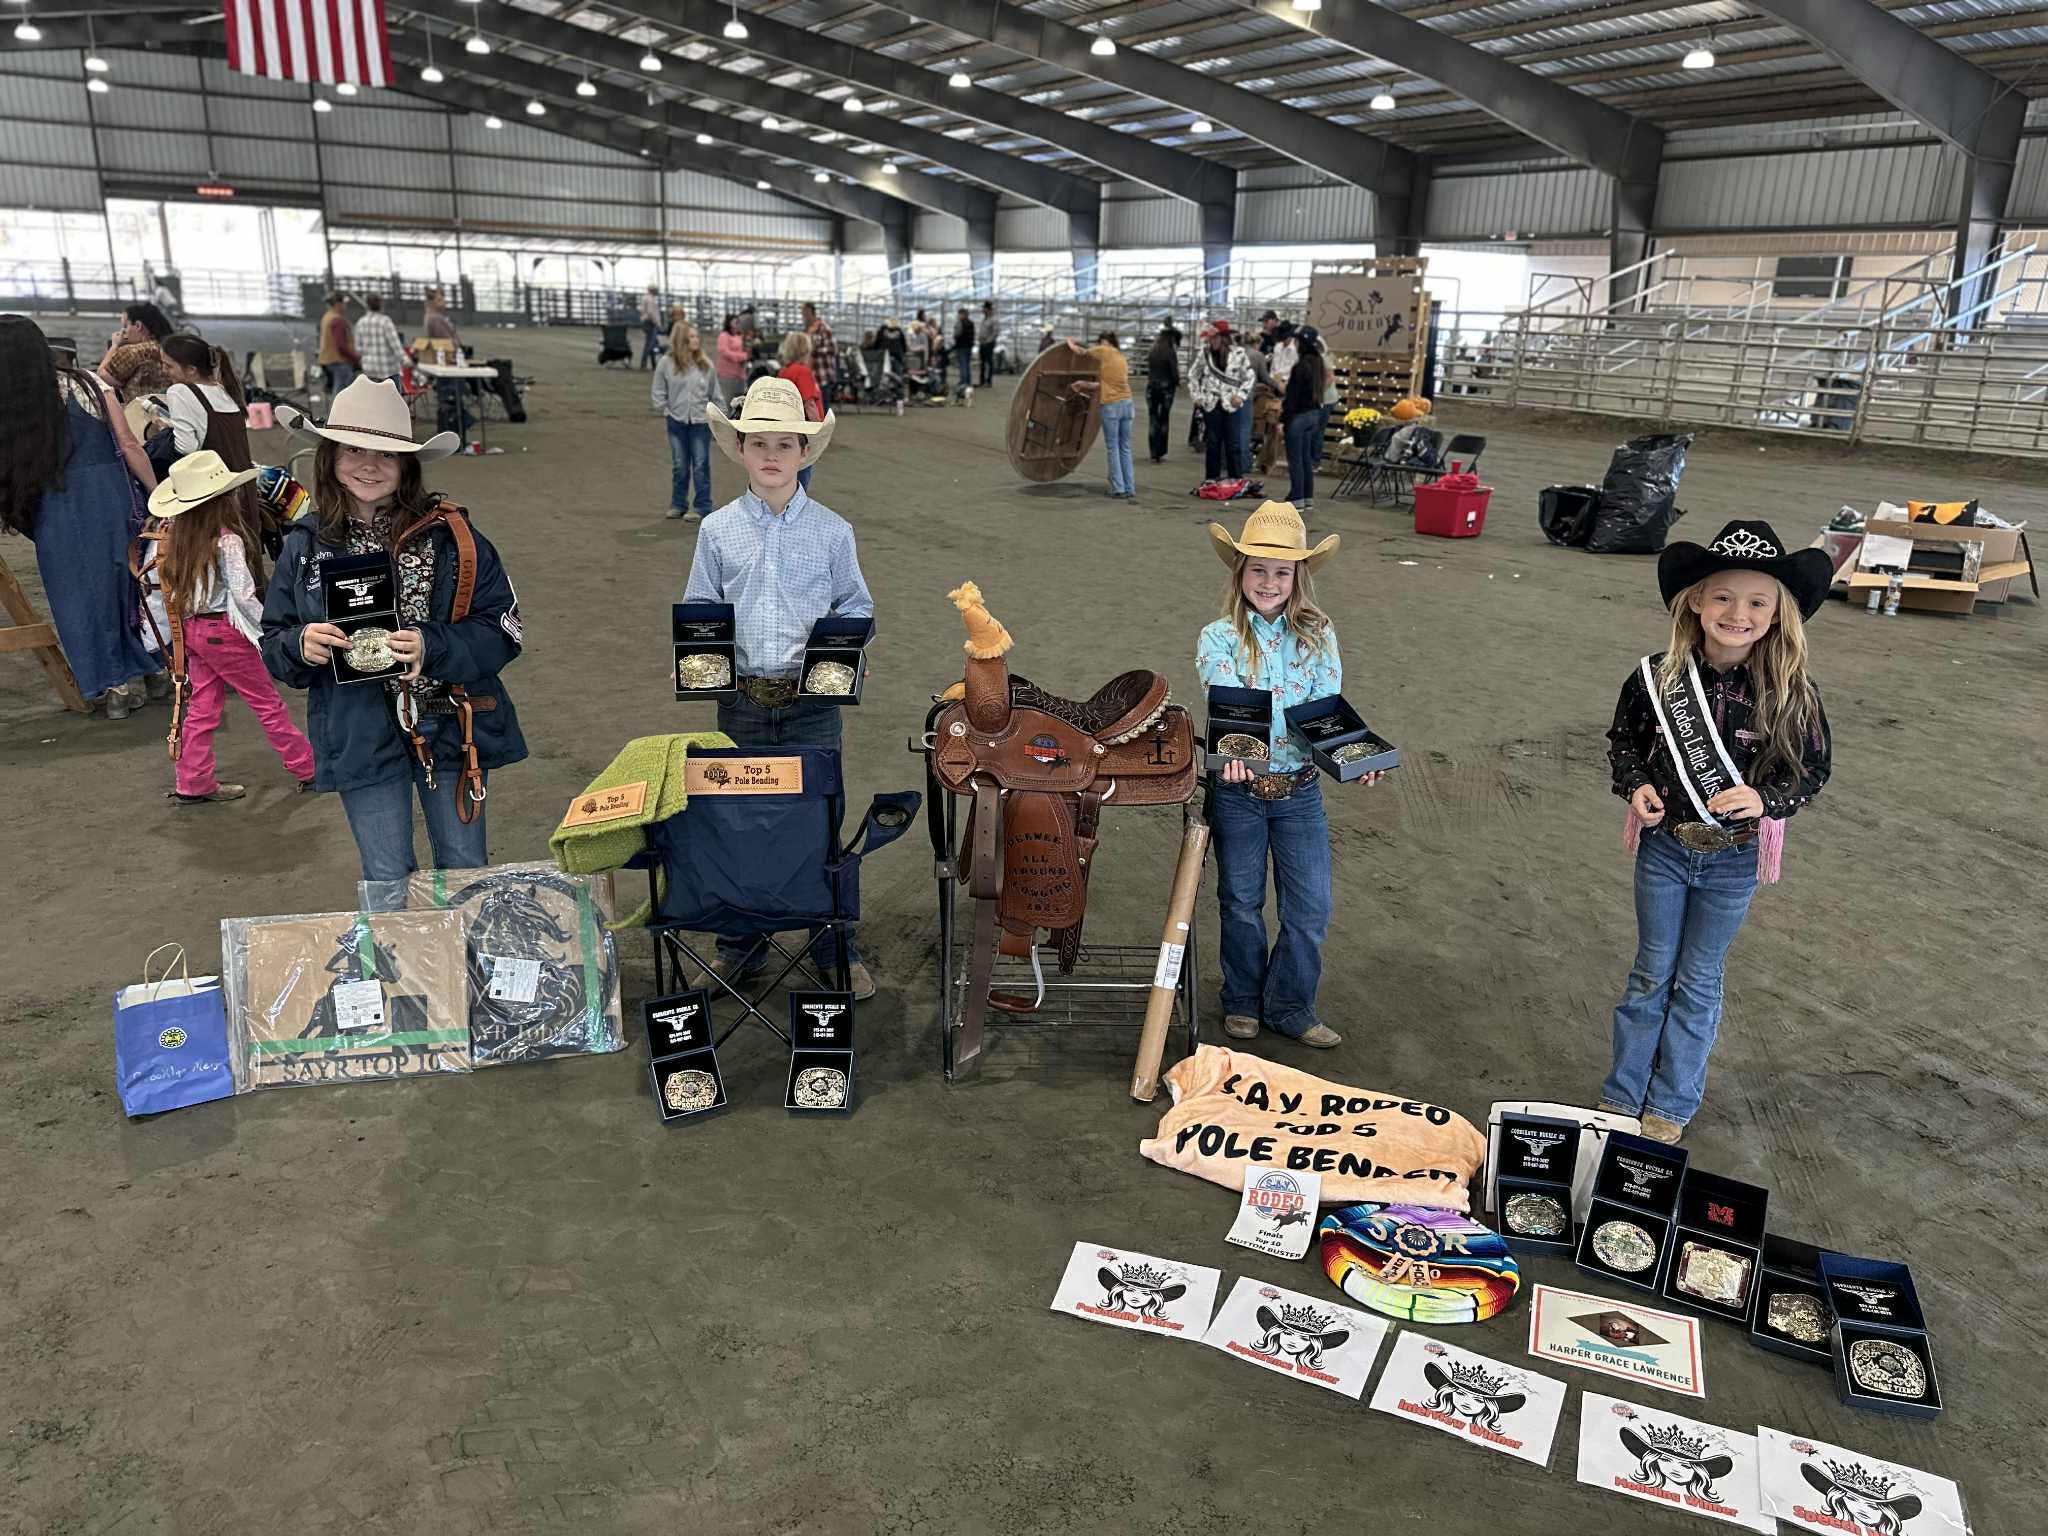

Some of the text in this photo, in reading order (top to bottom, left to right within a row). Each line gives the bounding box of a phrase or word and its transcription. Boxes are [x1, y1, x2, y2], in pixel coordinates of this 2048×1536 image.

[1670, 697, 1696, 738] Rodeo
[1683, 735, 1707, 771] Little
[734, 776, 750, 785] Pole
[743, 764, 771, 776] Top 5
[607, 793, 625, 804] Top 5
[283, 1056, 351, 1081] SAYR
[355, 1051, 409, 1075] TOP
[1320, 1094, 1451, 1126] RODEO
[1351, 1122, 1378, 1138] 5
[1175, 1123, 1278, 1162] POLE
[1247, 1189, 1304, 1211] RODEO
[1255, 1236, 1282, 1247] Top 10
[1258, 1229, 1284, 1239] Finals
[1228, 1236, 1302, 1258] MUTTON BUSTER
[1296, 1364, 1340, 1385] Winner
[1549, 1343, 1692, 1386] HARPER GRACE LAWRENCE
[1397, 1398, 1523, 1450] Interview Winner
[1614, 1475, 1739, 1517] Modeling Winner
